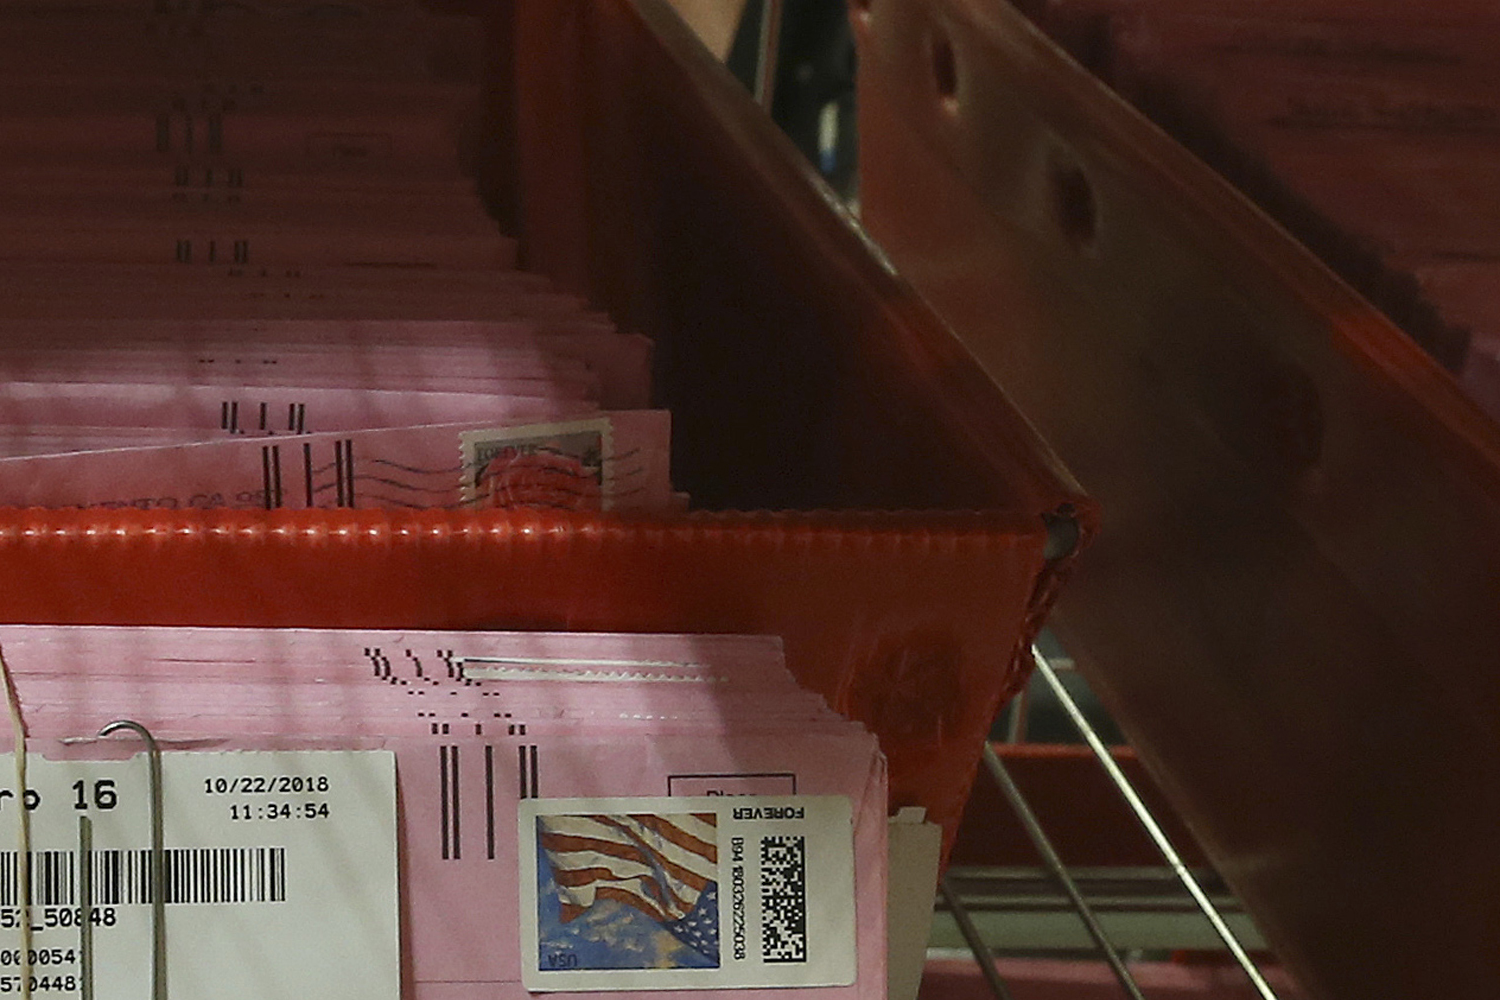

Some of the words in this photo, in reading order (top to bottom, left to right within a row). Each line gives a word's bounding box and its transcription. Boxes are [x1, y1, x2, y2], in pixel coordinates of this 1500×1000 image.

[204, 776, 329, 794] 10/22/2018
[73, 780, 117, 810] 16
[230, 803, 329, 820] 11:34:54
[733, 806, 805, 820] FOREVER
[547, 953, 578, 967] USA
